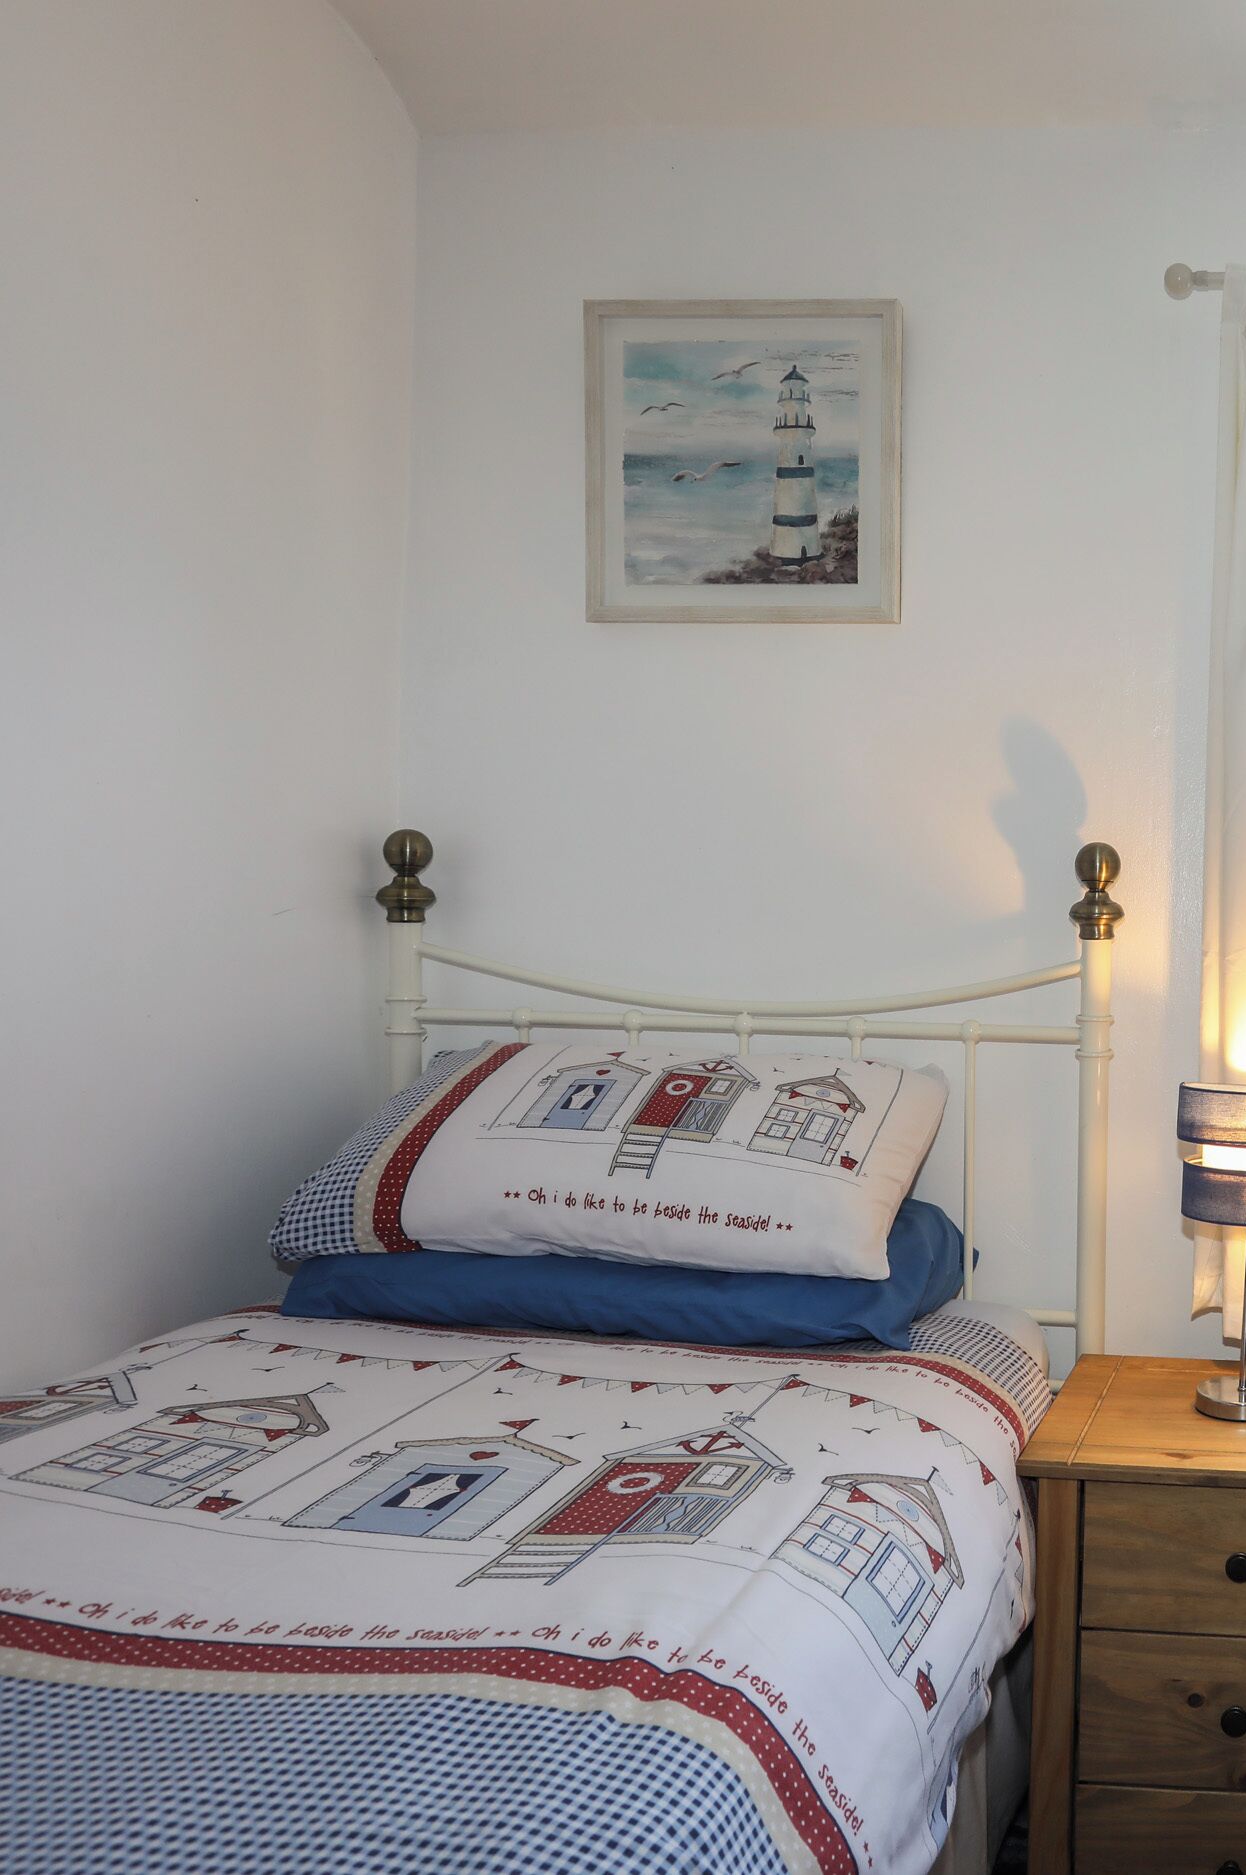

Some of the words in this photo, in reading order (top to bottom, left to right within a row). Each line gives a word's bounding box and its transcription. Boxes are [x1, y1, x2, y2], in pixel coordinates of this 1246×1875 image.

[528, 1187, 546, 1205] Oh
[553, 1190, 559, 1203] i
[564, 1191, 577, 1208] do
[583, 1192, 605, 1210] like
[612, 1195, 626, 1213] to
[632, 1198, 648, 1216] be
[653, 1201, 691, 1221] beside
[698, 1206, 719, 1225] the
[724, 1213, 771, 1232] seaside!
[78, 1602, 114, 1619] Oh
[115, 1608, 135, 1620] i
[131, 1610, 158, 1626] do
[161, 1613, 208, 1630] like
[212, 1617, 240, 1634] to
[243, 1620, 281, 1636] be
[282, 1622, 354, 1640] beside
[360, 1624, 400, 1640] the
[405, 1626, 491, 1642] seaside!
[531, 1624, 562, 1641] Oh
[571, 1628, 585, 1641] i
[587, 1631, 612, 1649] do
[619, 1631, 660, 1651] like
[667, 1646, 689, 1664] to
[697, 1649, 727, 1670] be
[732, 1664, 788, 1715] beside
[792, 1718, 817, 1756] the
[818, 1764, 864, 1837] seaside!
